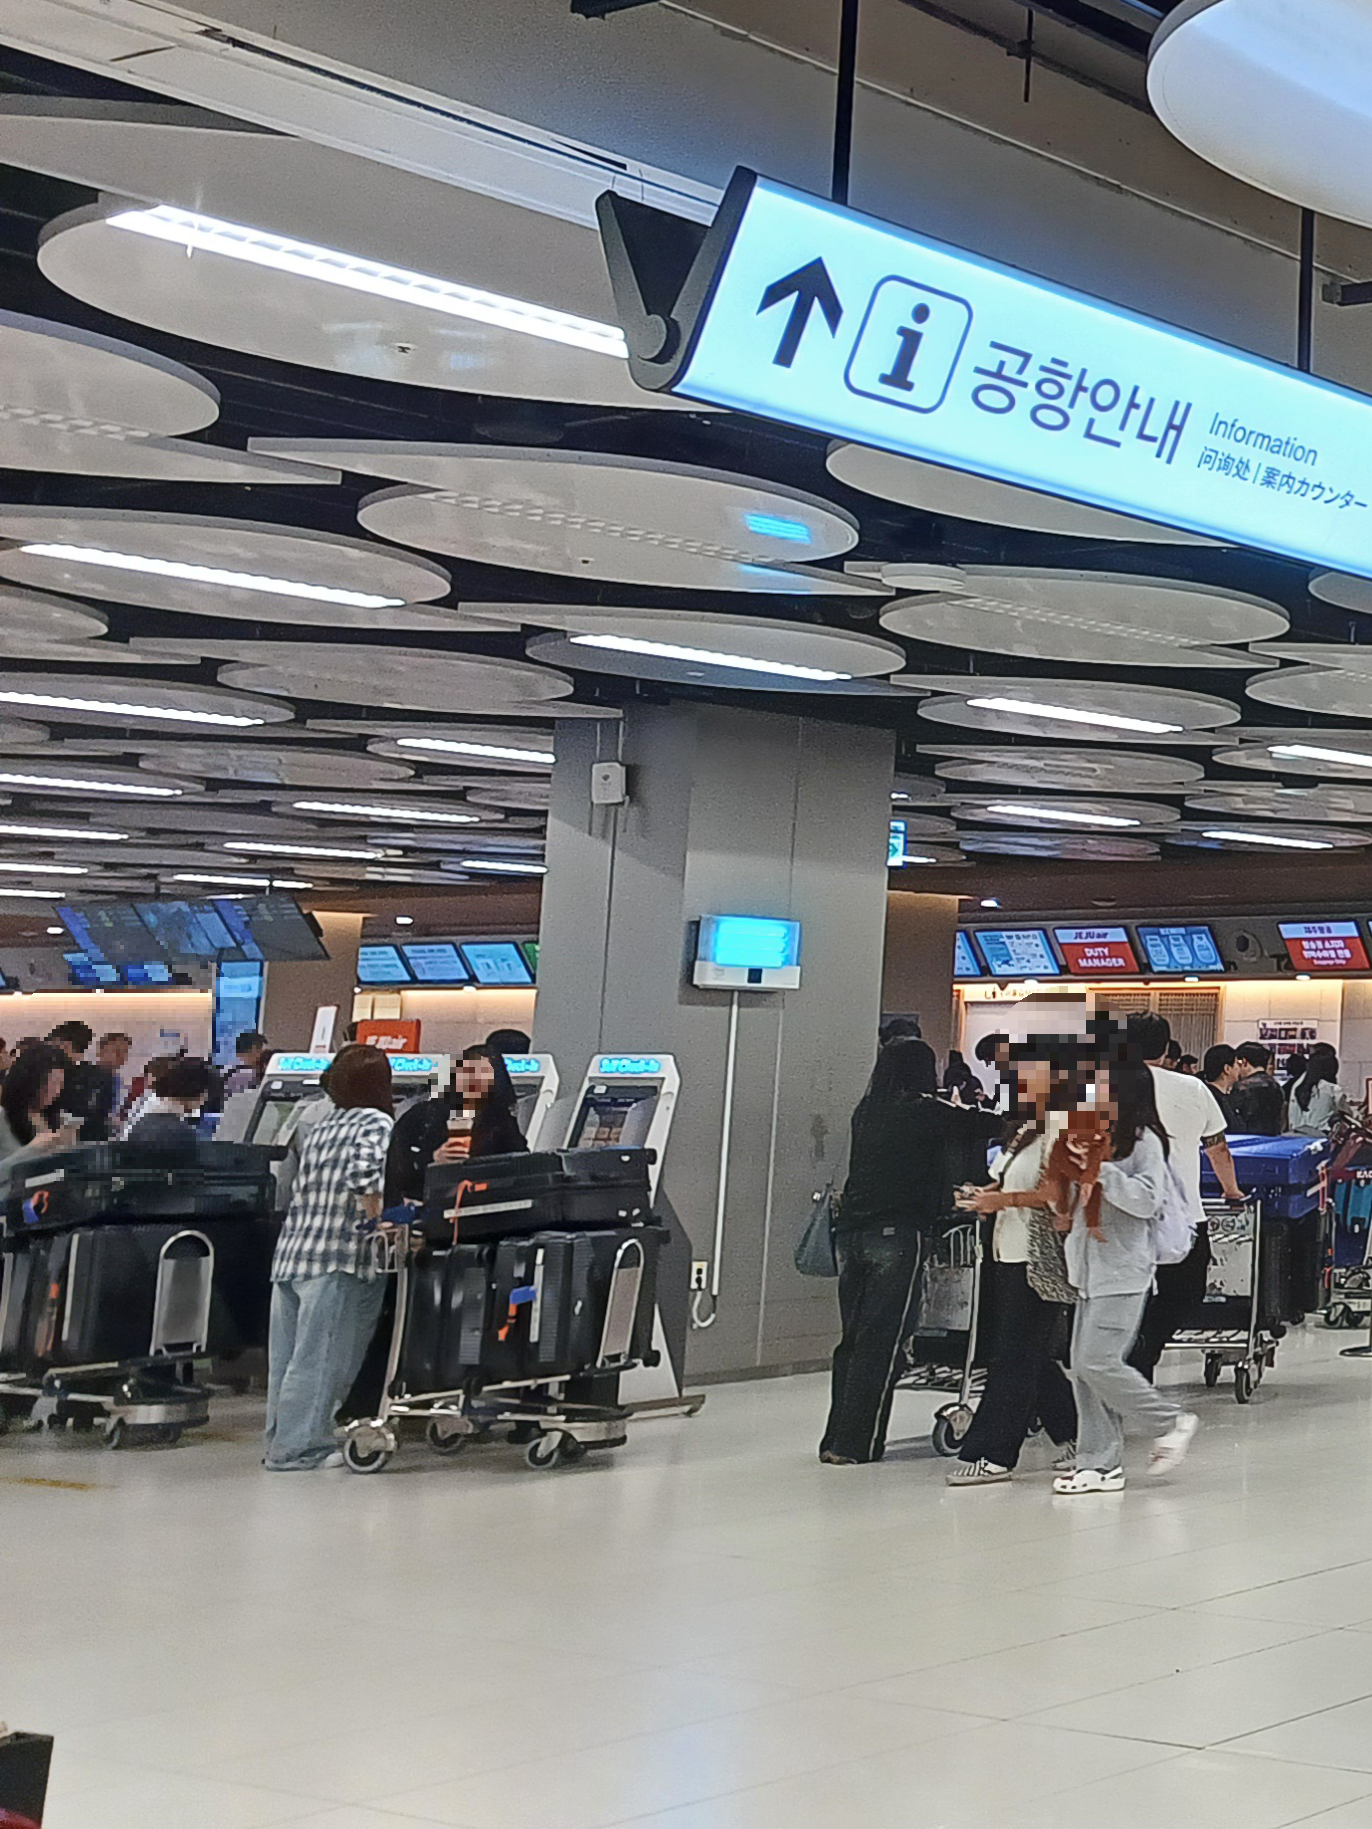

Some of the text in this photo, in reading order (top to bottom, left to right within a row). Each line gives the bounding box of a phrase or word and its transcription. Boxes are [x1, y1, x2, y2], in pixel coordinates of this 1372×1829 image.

[971, 340, 1192, 464] 공항안내
[1208, 412, 1318, 466] Information
[1197, 446, 1368, 511] 问询处 案内カウンター
[1073, 931, 1109, 940] JEJUair
[1083, 946, 1110, 957] DUTY
[1077, 957, 1126, 968] MANAGER
